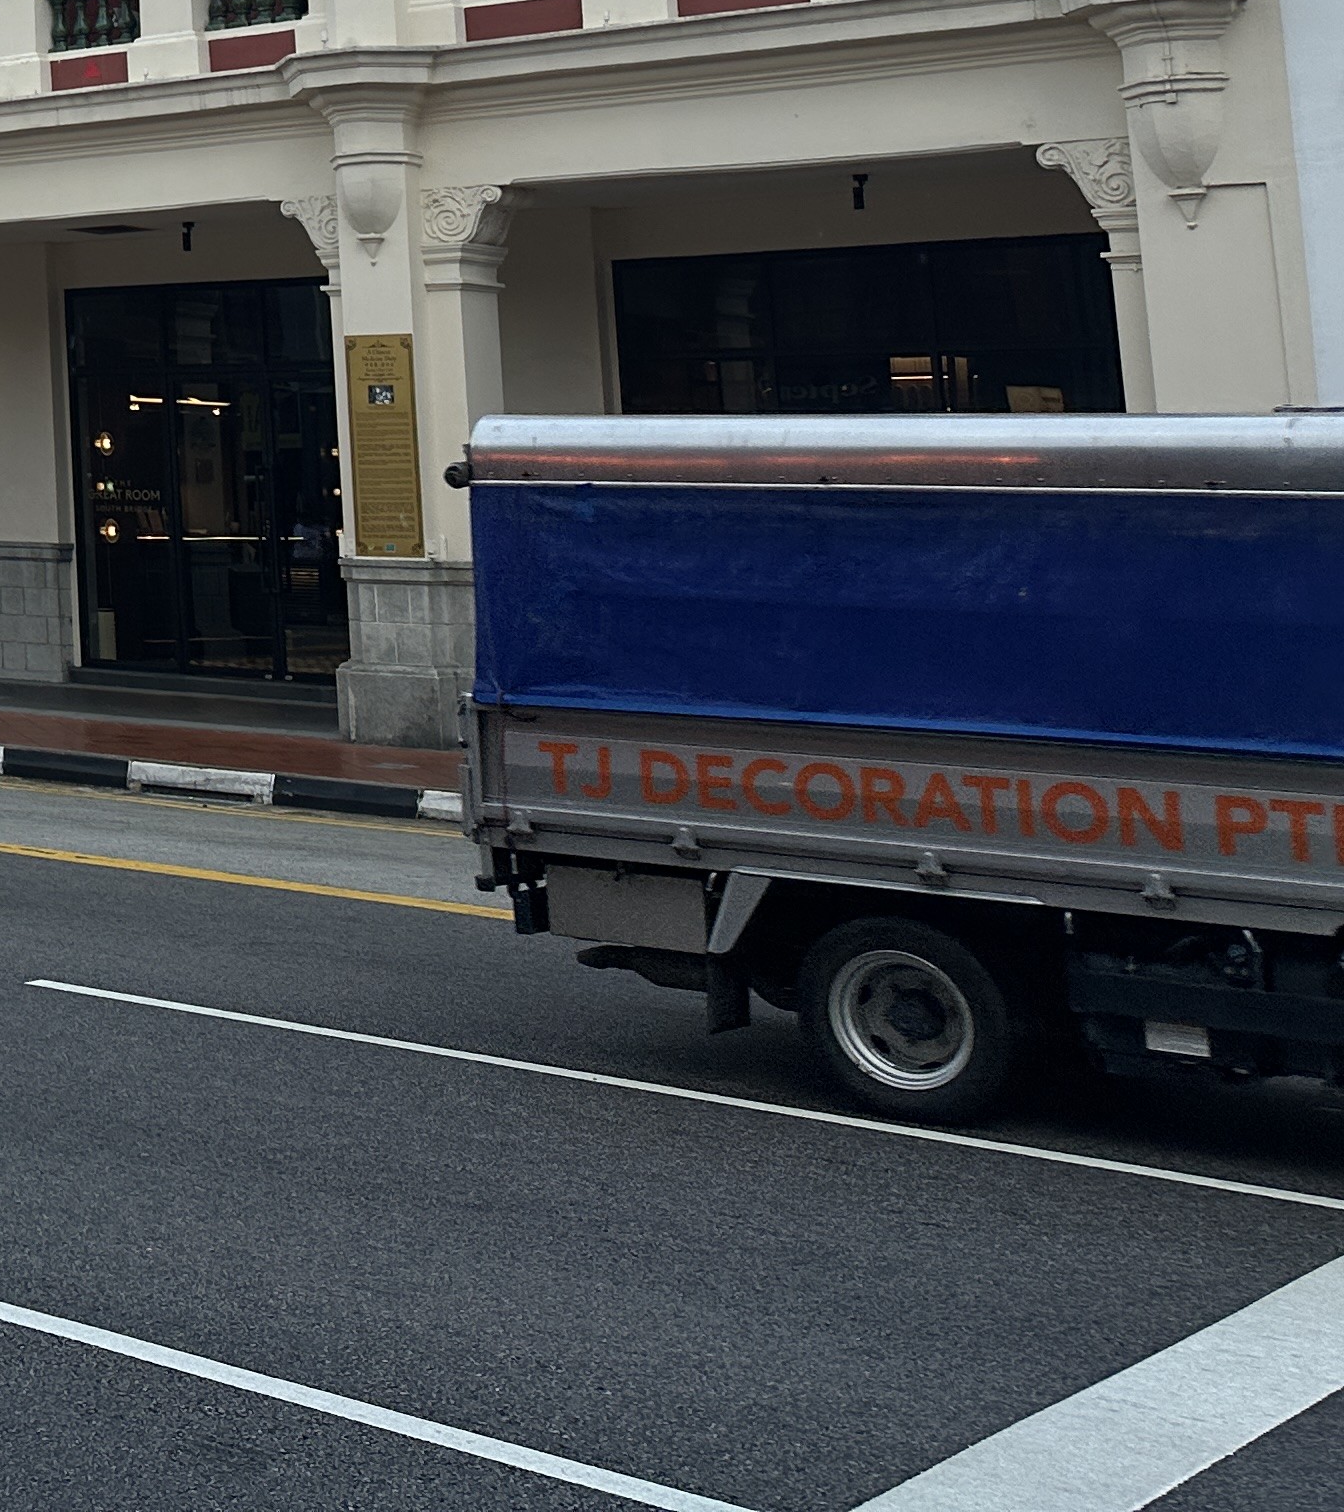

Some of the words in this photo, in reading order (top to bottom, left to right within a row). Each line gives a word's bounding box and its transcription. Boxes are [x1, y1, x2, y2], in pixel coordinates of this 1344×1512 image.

[88, 488, 123, 500] GREAT
[126, 489, 161, 501] ROOM
[537, 741, 612, 798] TJ
[639, 750, 1184, 852] DECORATION
